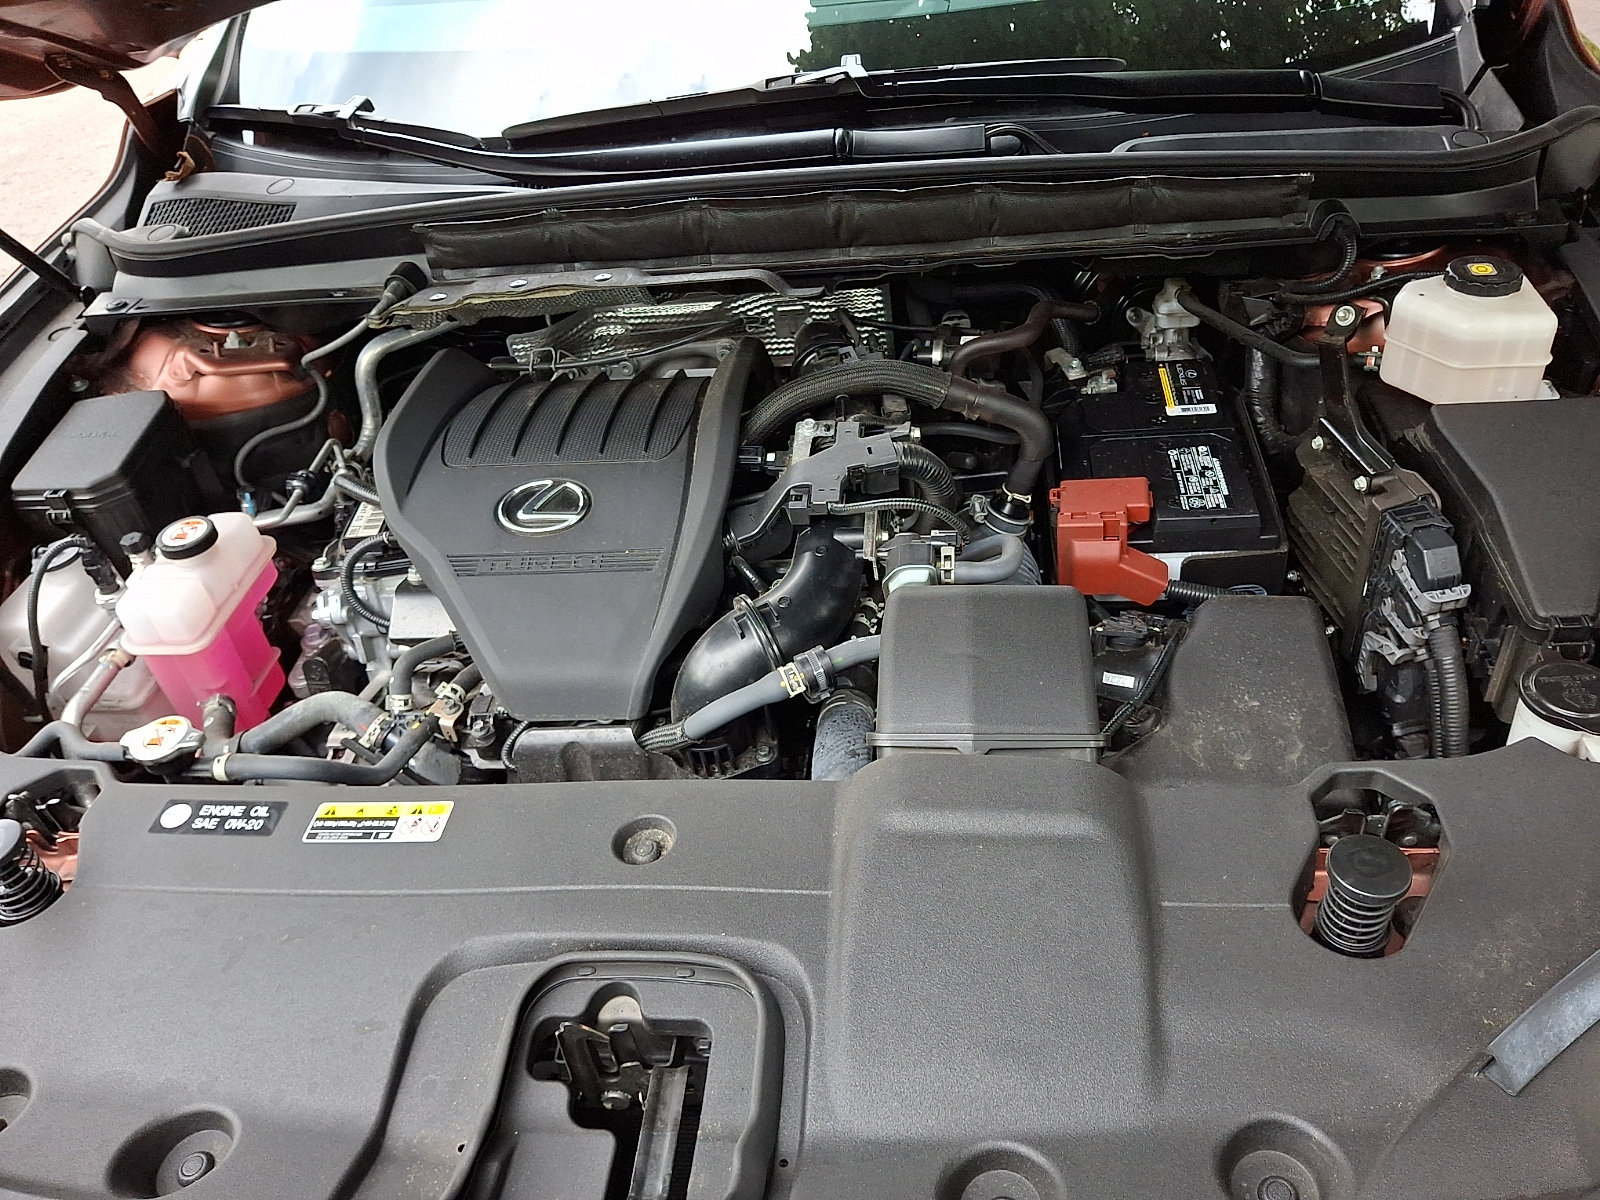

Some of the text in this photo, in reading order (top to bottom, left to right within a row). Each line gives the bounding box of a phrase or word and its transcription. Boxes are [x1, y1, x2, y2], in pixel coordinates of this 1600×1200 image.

[1175, 363, 1188, 386] LEXUS
[199, 804, 270, 818] ENGINE OIL
[191, 817, 264, 831] SAE 0W-20
